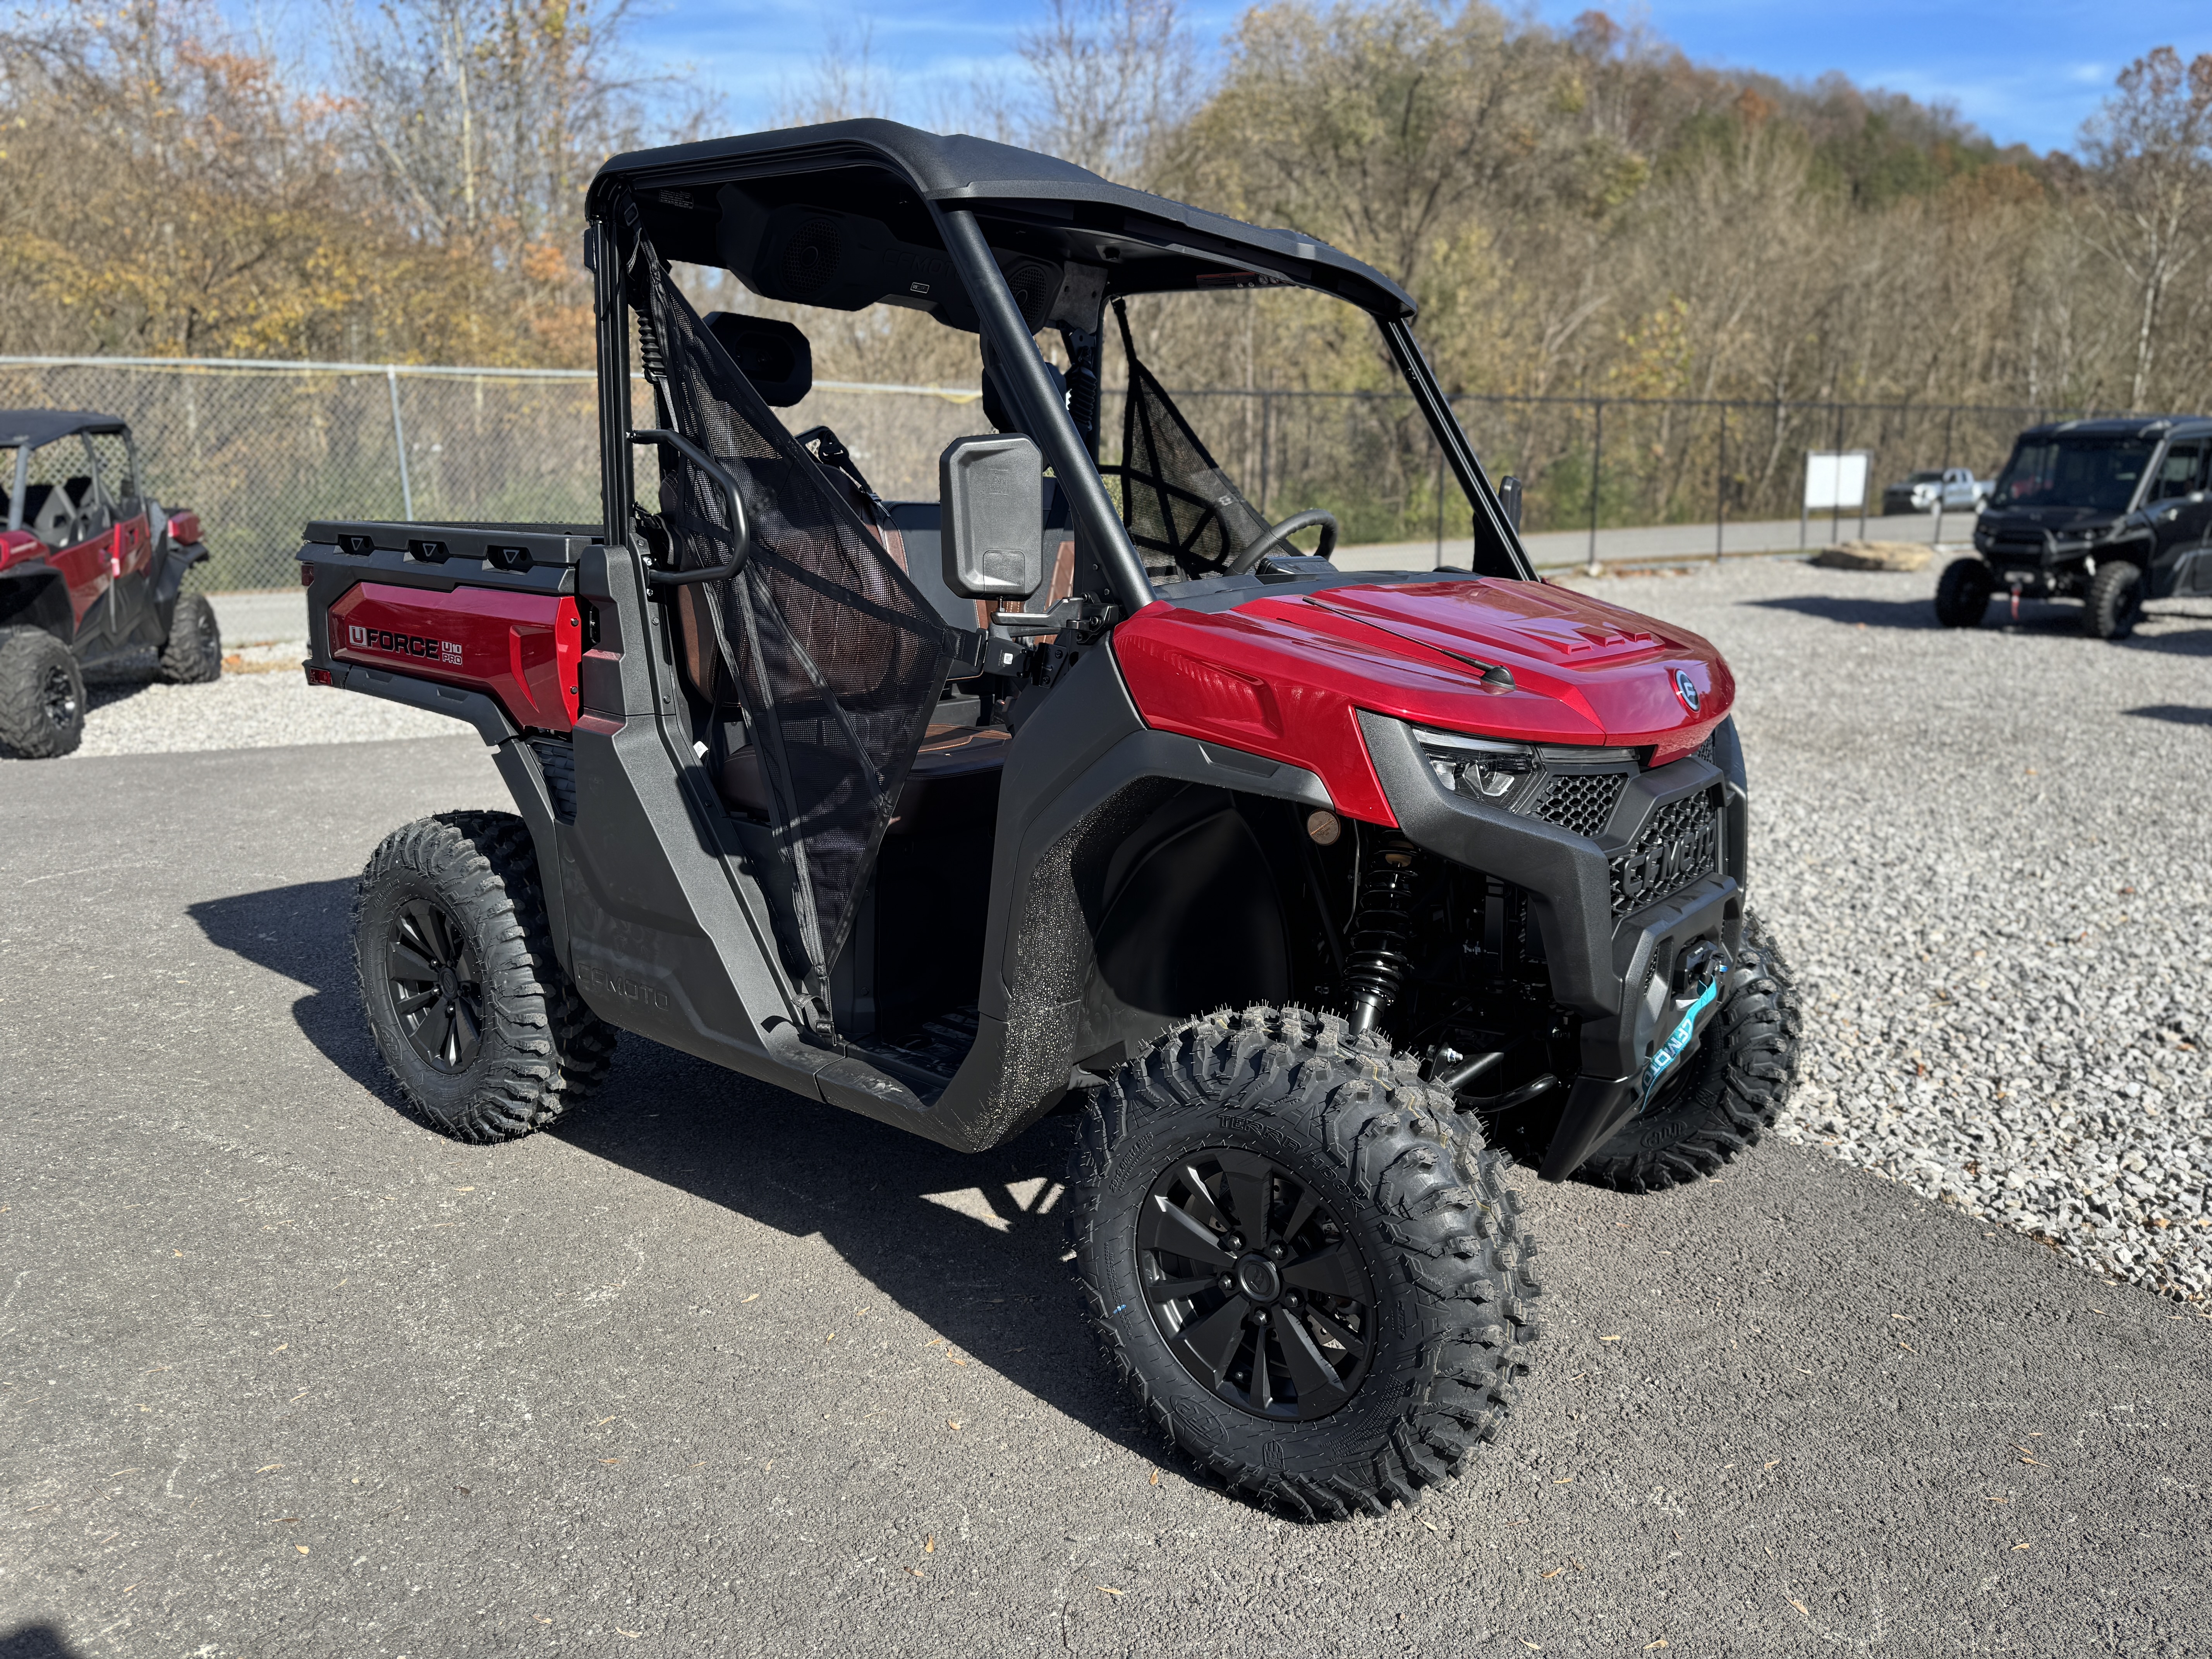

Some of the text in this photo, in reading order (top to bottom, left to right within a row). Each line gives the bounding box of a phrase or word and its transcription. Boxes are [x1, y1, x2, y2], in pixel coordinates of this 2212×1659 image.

[441, 641, 462, 654] U10
[442, 653, 462, 665] PRO
[1623, 818, 1716, 896] CFMOTO
[578, 963, 669, 1011] CFMOTO
[1643, 1018, 1692, 1087] CFMOTO
[1218, 1114, 1365, 1218] TERRA HOOK
[1175, 1401, 1225, 1439] ITP
